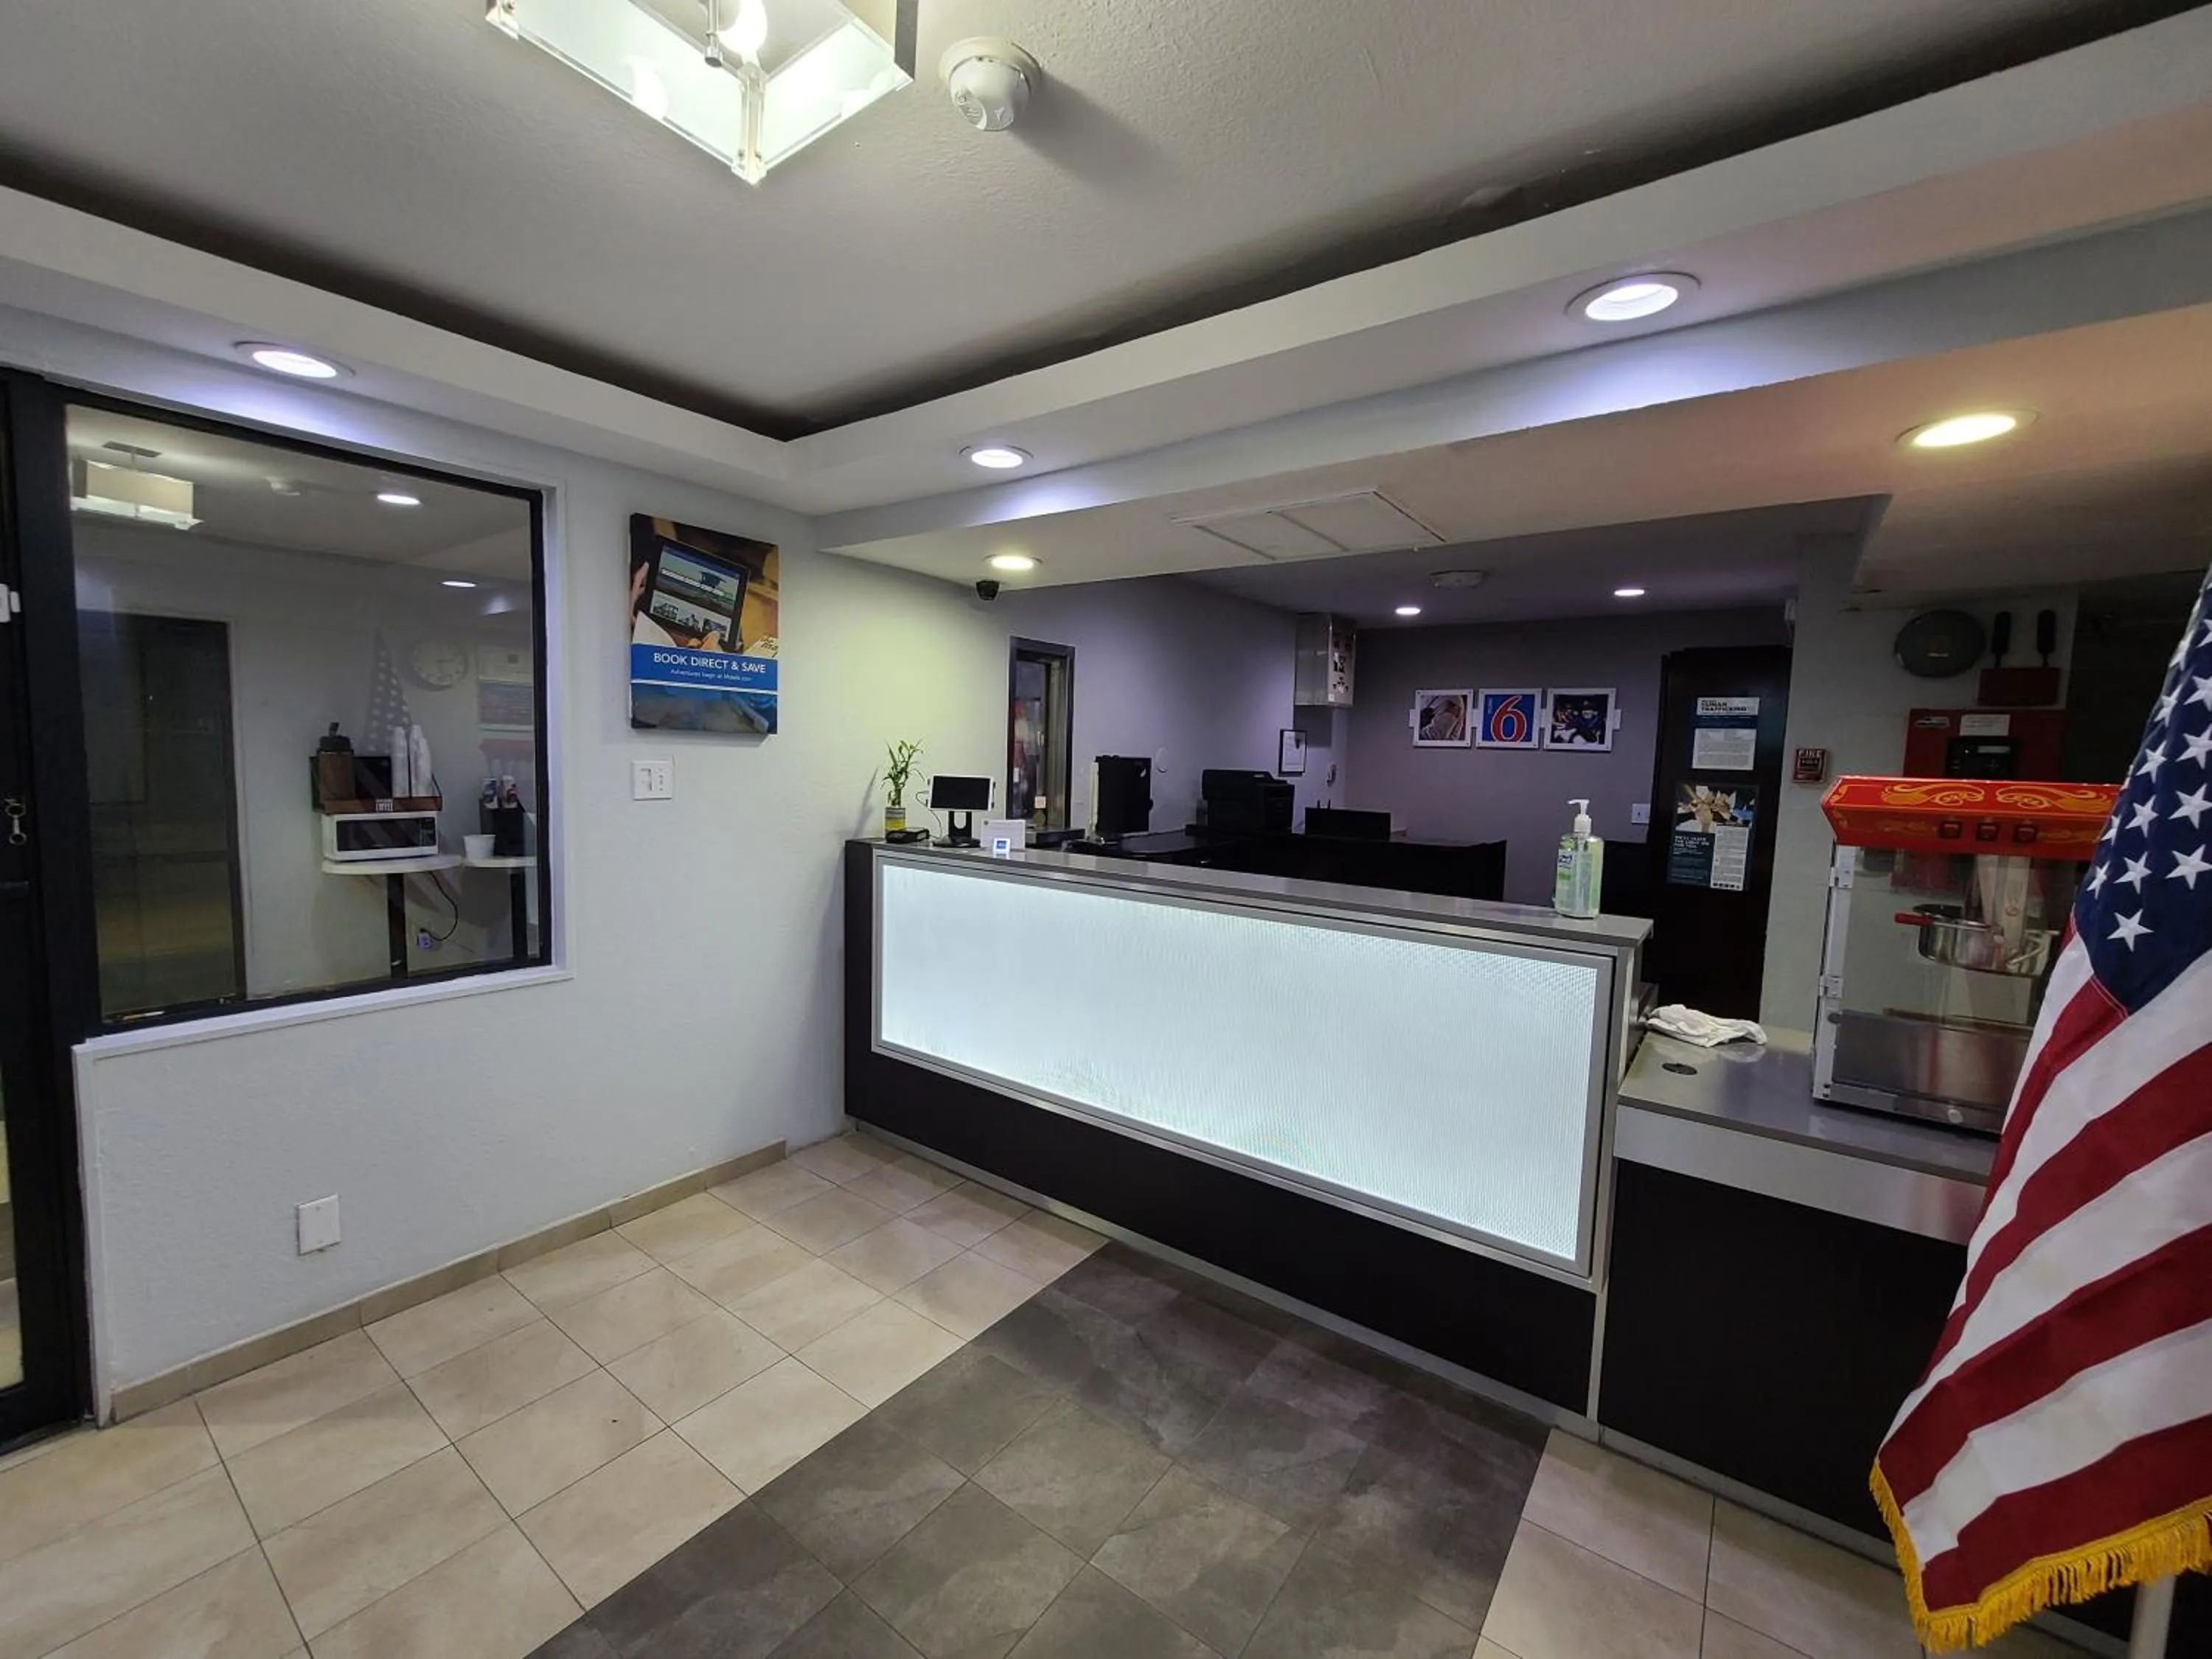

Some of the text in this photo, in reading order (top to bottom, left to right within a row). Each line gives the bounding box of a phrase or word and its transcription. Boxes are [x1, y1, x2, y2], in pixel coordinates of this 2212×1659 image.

[653, 653, 766, 673] BOOK DIRECT & SAVE
[1490, 695, 1523, 742] 6
